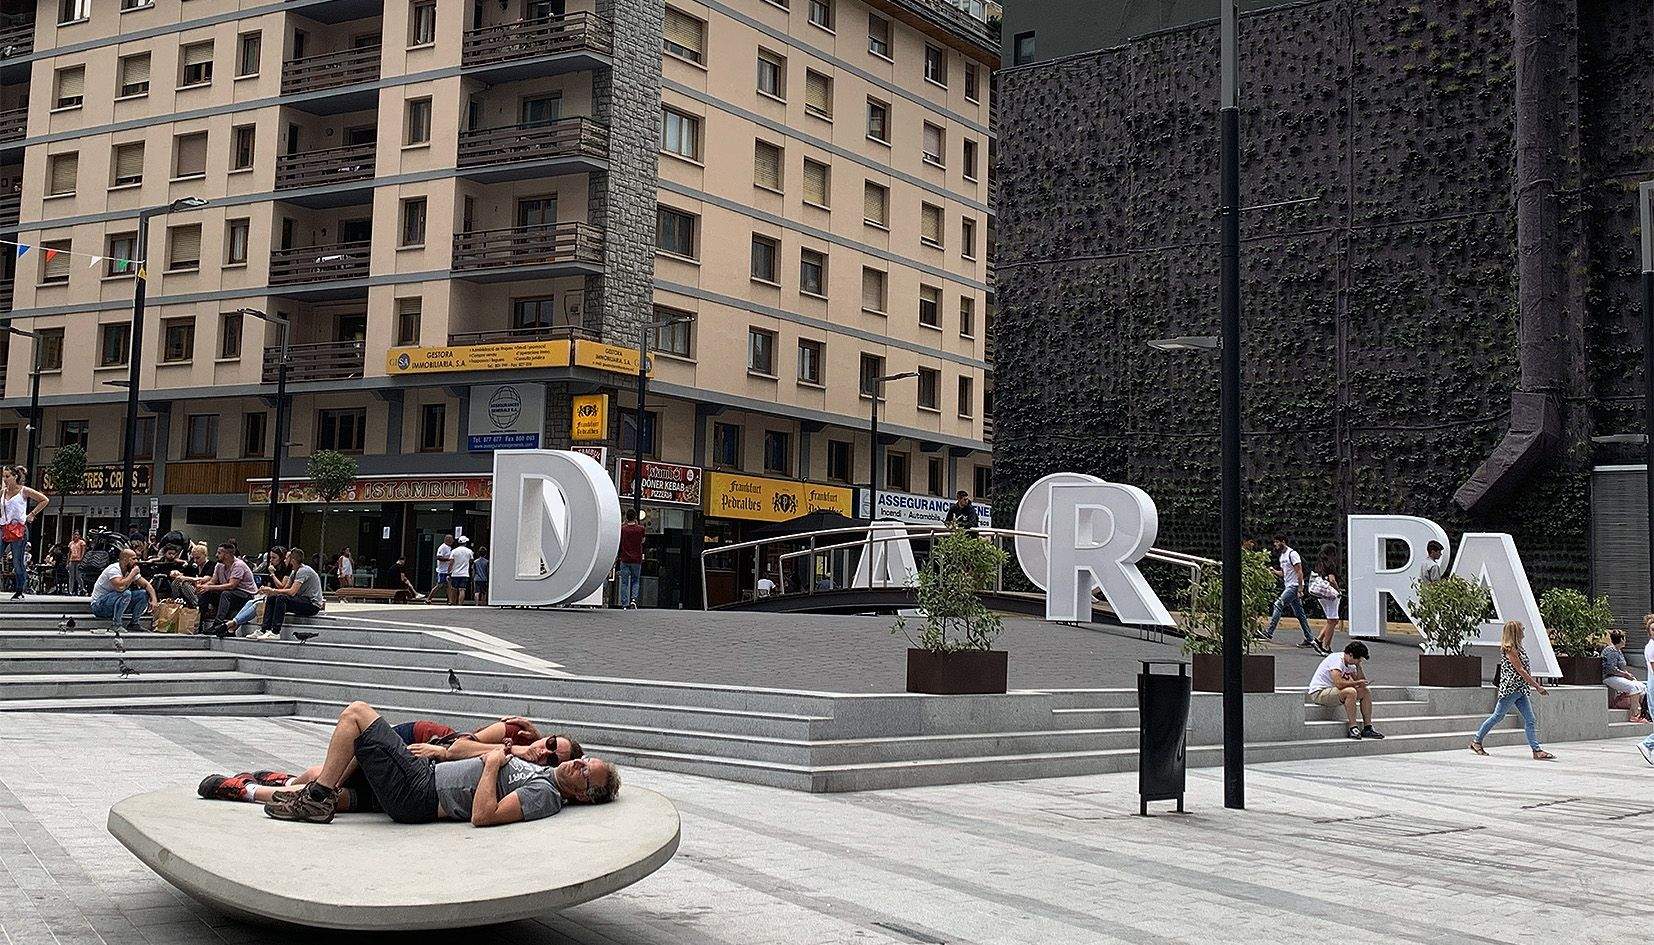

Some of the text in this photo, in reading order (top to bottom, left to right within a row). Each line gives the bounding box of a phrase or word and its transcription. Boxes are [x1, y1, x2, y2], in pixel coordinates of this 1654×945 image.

[426, 351, 454, 359] GESTORA
[363, 480, 470, 500] ISTAMBUL
[664, 480, 685, 492] KEBAB
[728, 480, 762, 494] Frankfurt
[721, 493, 762, 511] Pedralbes
[808, 489, 838, 502] Frankfurt
[878, 494, 957, 513] ASSEGURANC
[488, 449, 622, 606] D
[1046, 482, 1177, 626] R
